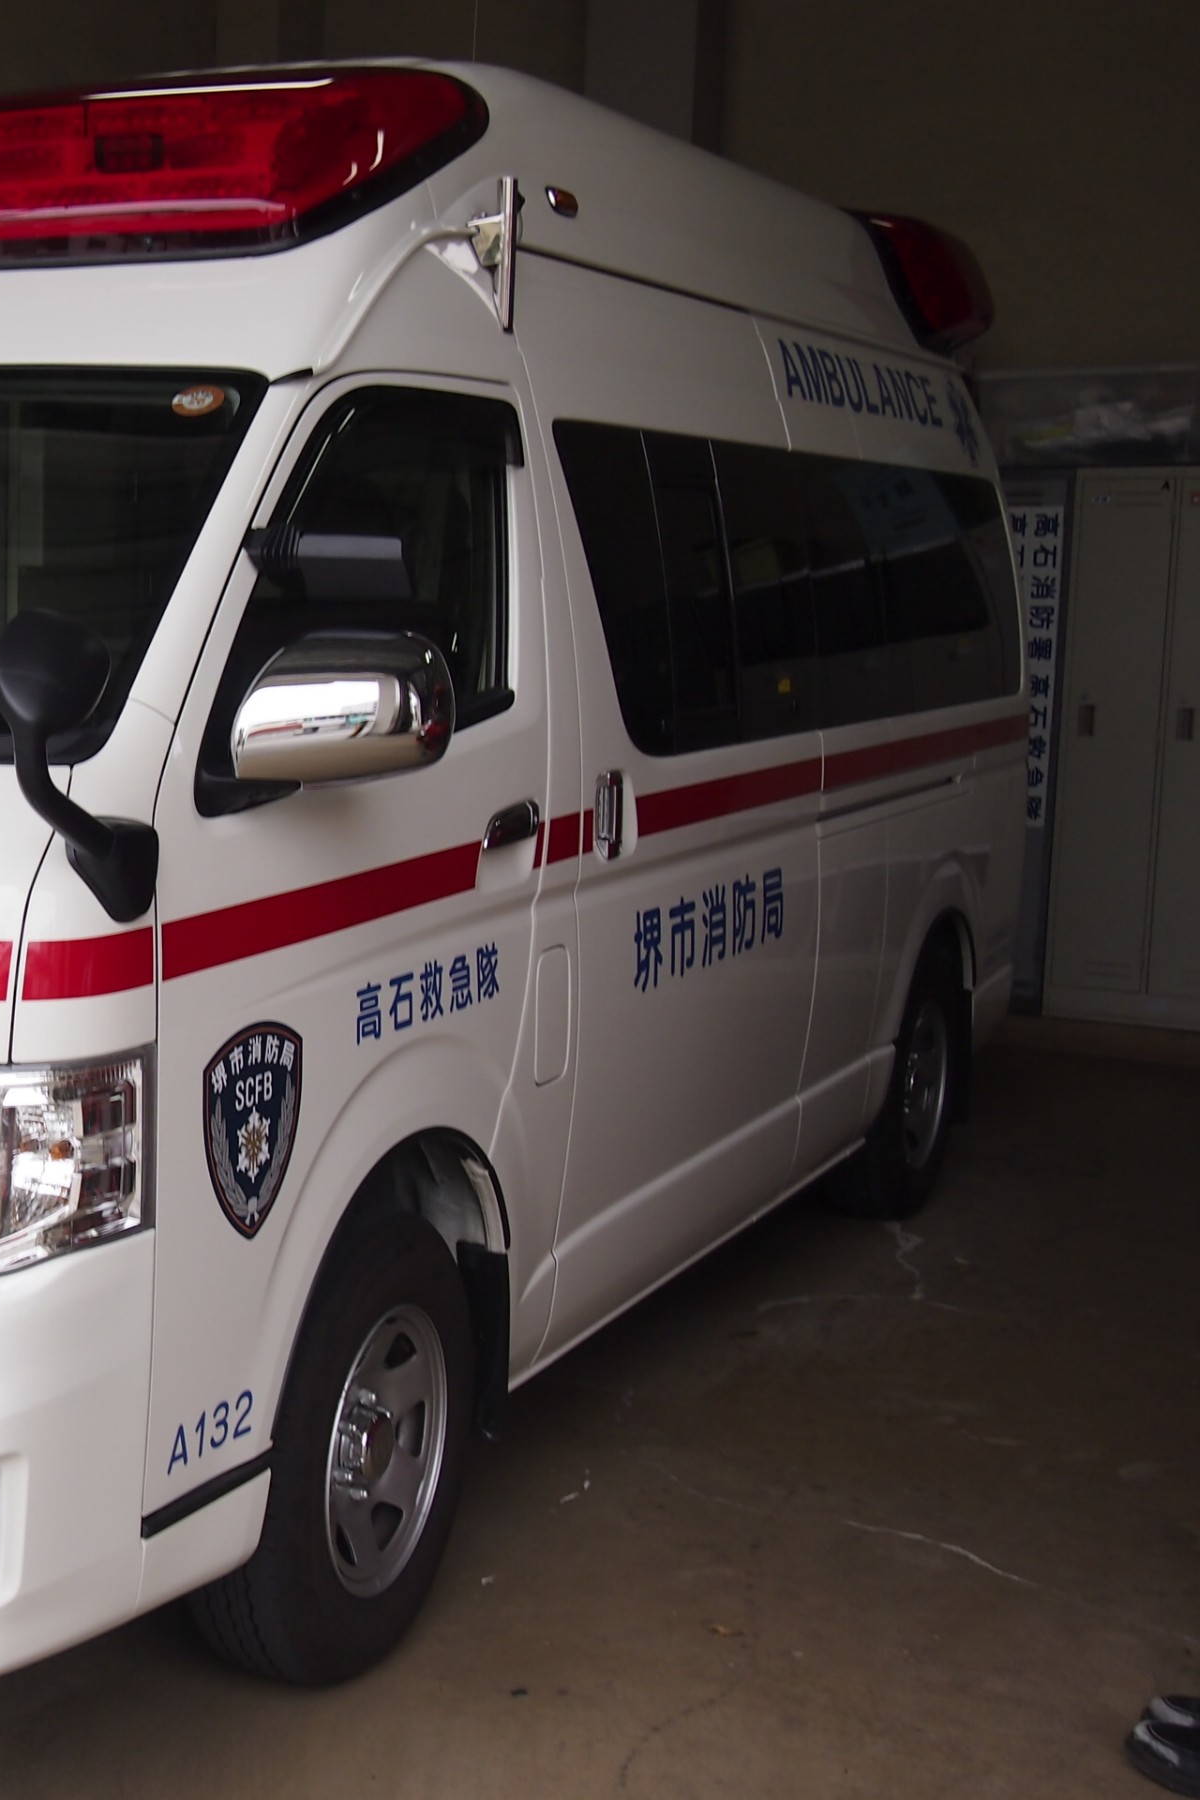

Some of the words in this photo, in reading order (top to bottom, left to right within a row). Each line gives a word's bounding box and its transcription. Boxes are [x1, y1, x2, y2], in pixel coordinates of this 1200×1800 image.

[778, 339, 944, 428] AMBULANCE
[1027, 513, 1060, 661] 高石消防署
[634, 867, 784, 993] 堺市消防局
[355, 942, 500, 1045] 高石救急隊
[211, 1034, 296, 1095] 堺市消防局
[235, 1070, 273, 1112] SCFB
[167, 1389, 253, 1475] A132
